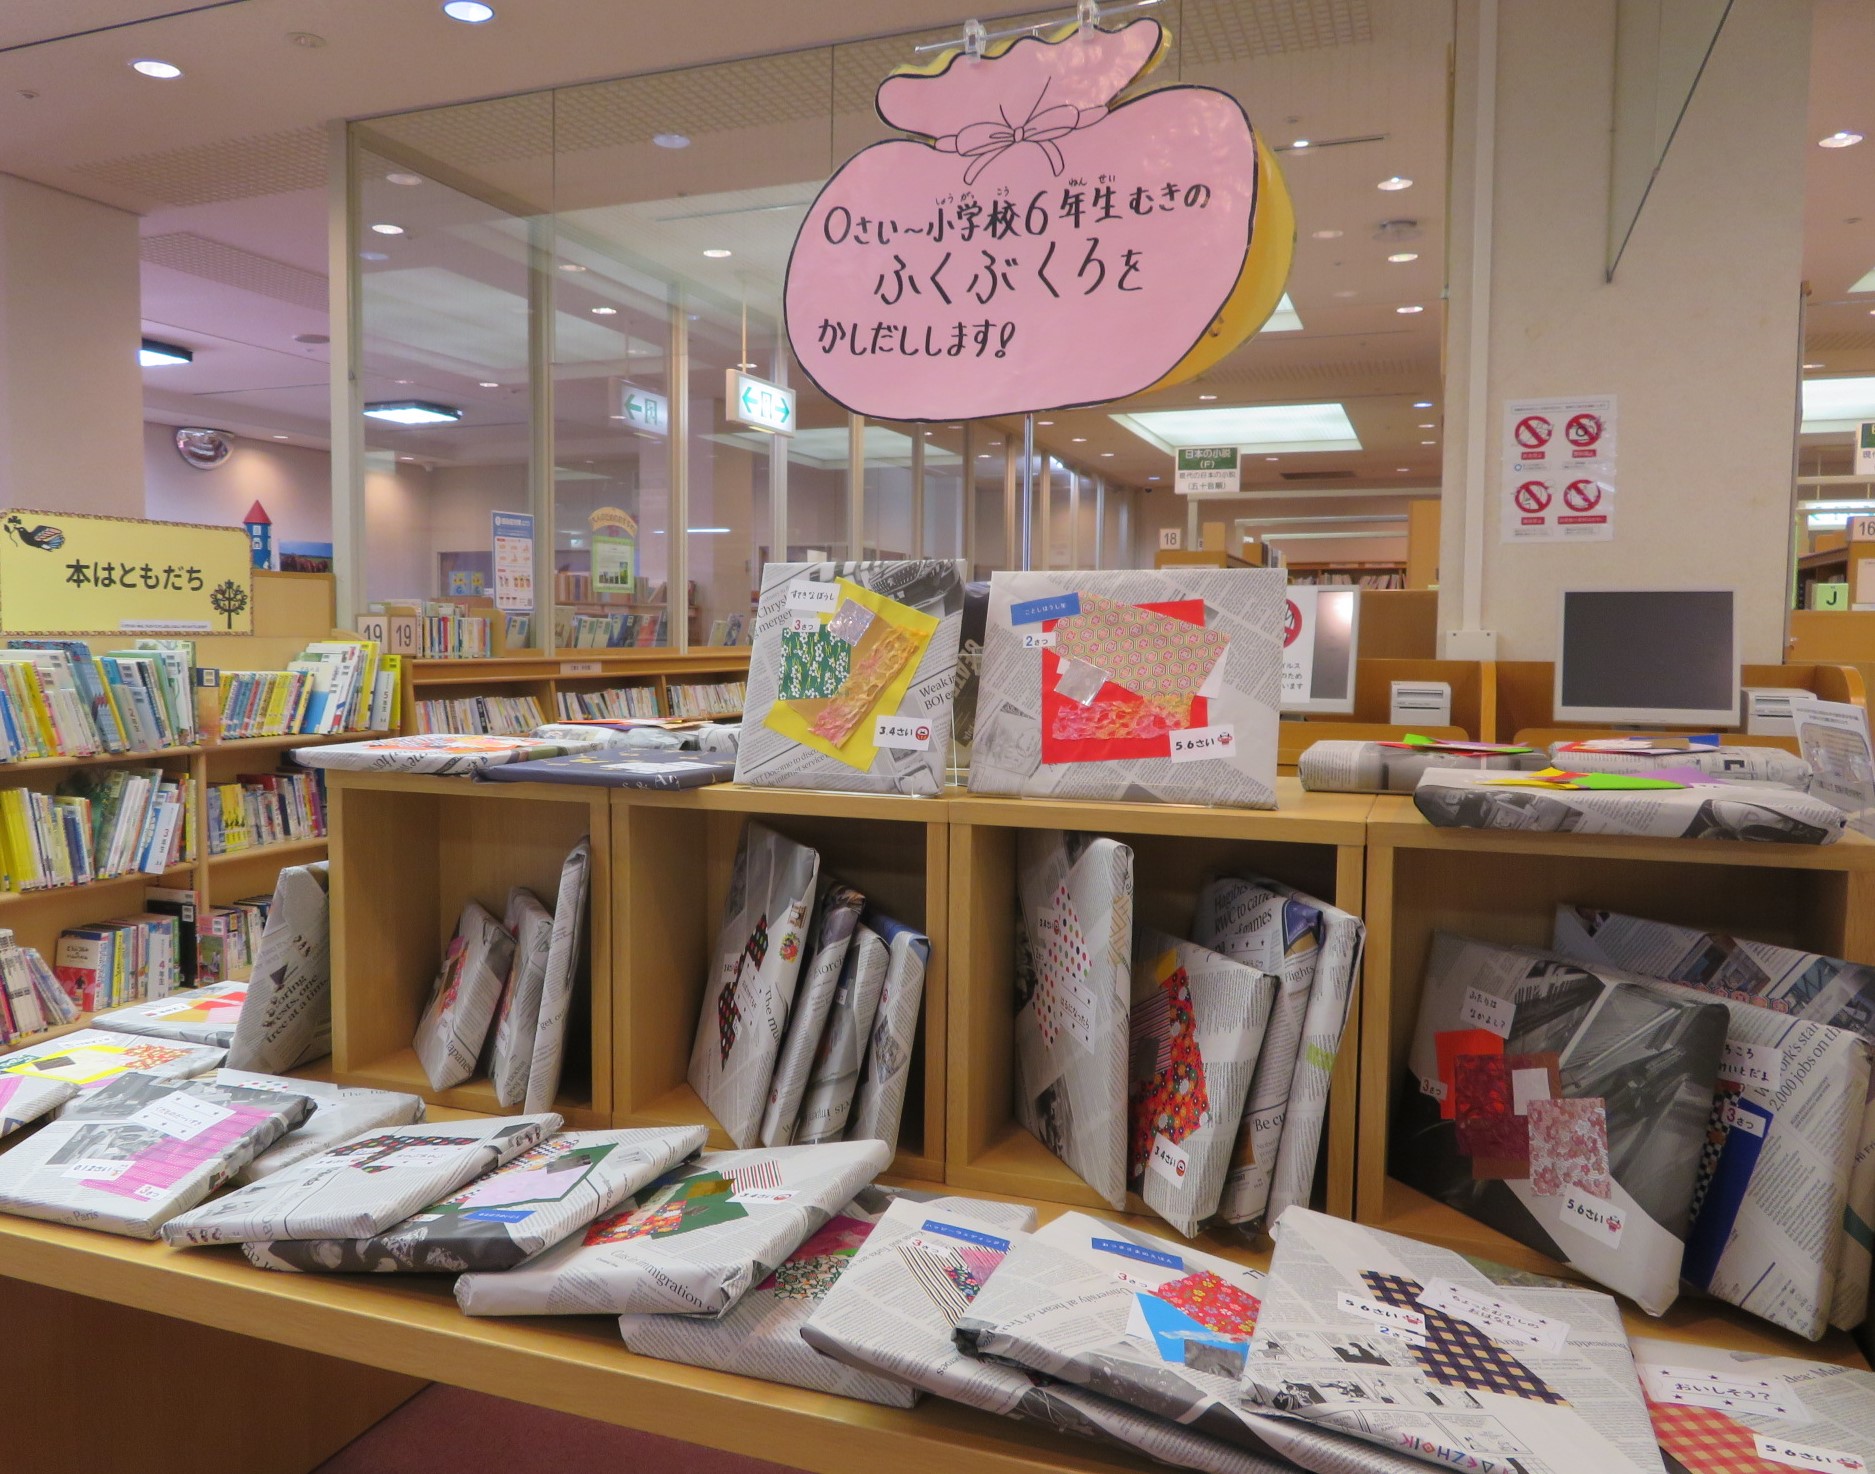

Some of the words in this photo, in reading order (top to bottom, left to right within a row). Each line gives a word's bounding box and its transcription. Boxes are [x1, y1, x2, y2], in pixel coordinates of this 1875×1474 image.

[873, 236, 1144, 305] ふくぶくろを
[1200, 460, 1215, 469] (F)
[1164, 531, 1178, 546] 18
[65, 558, 204, 592] 本はともだち
[1825, 590, 1838, 606] J
[758, 608, 793, 632] merger
[794, 619, 814, 631] 3さつ
[395, 624, 412, 648] 19
[1025, 635, 1049, 647] 2さつ
[919, 677, 948, 698] Weak
[924, 693, 945, 711] BOJ
[1285, 965, 1316, 983] Flights
[540, 1018, 555, 1031] get
[1769, 1078, 1798, 1112] 2,000
[1795, 1056, 1817, 1085] jobs
[1812, 1039, 1830, 1059] on
[1726, 1106, 1755, 1130] 3さつ
[73, 1210, 100, 1222] Paris
[1117, 1272, 1148, 1288] 3さつ
[1079, 1287, 1134, 1304] University
[1379, 1325, 1413, 1342] 2さつ
